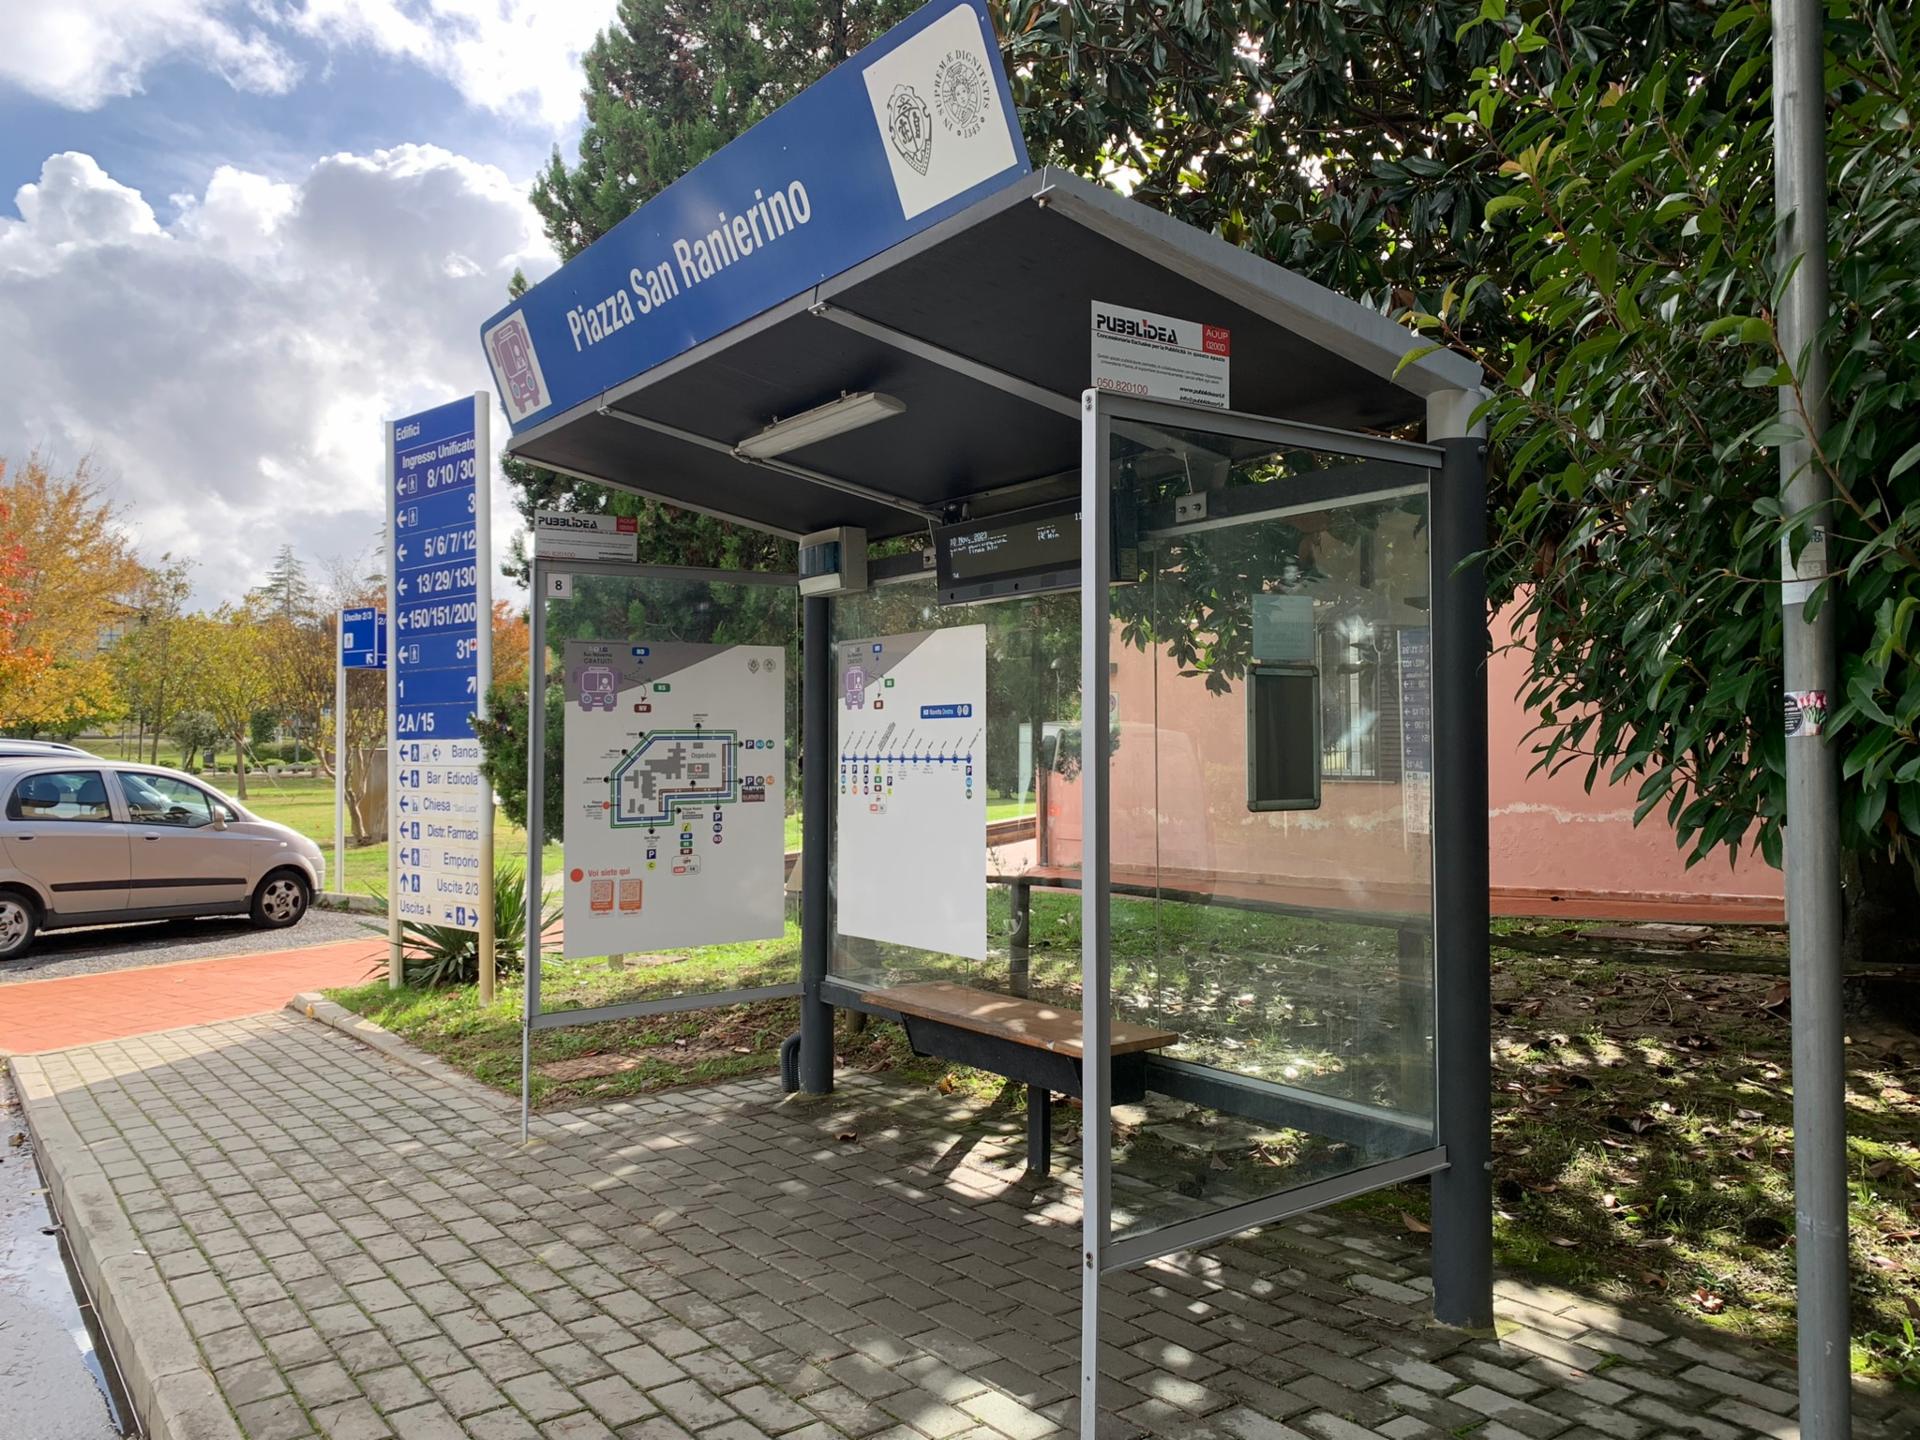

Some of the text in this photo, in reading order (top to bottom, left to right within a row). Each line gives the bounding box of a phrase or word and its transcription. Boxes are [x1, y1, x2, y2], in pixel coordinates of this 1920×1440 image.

[566, 180, 811, 352] Piazza San Ranierino
[1205, 328, 1228, 339] AOUP
[396, 423, 420, 441] Edifici
[402, 438, 475, 470] Ingresso Unificato
[427, 457, 475, 489] 8/10/30
[467, 492, 476, 513] 3
[424, 529, 476, 558] 5/6/7/12
[416, 565, 476, 594] 13/29/130
[554, 579, 563, 591] 8
[409, 602, 476, 629] 150/151/200
[456, 639, 470, 660] 31
[398, 679, 404, 699] 1
[398, 712, 435, 732] 2A/15
[452, 744, 478, 759] Banca
[427, 771, 440, 785] Bar
[447, 771, 478, 786] Edicola
[423, 797, 451, 812] Chiesa
[447, 825, 479, 841] Farmaci
[443, 851, 479, 869] Emporio
[437, 878, 479, 896] Uscite 2/3
[400, 899, 432, 915] Uscita 4
